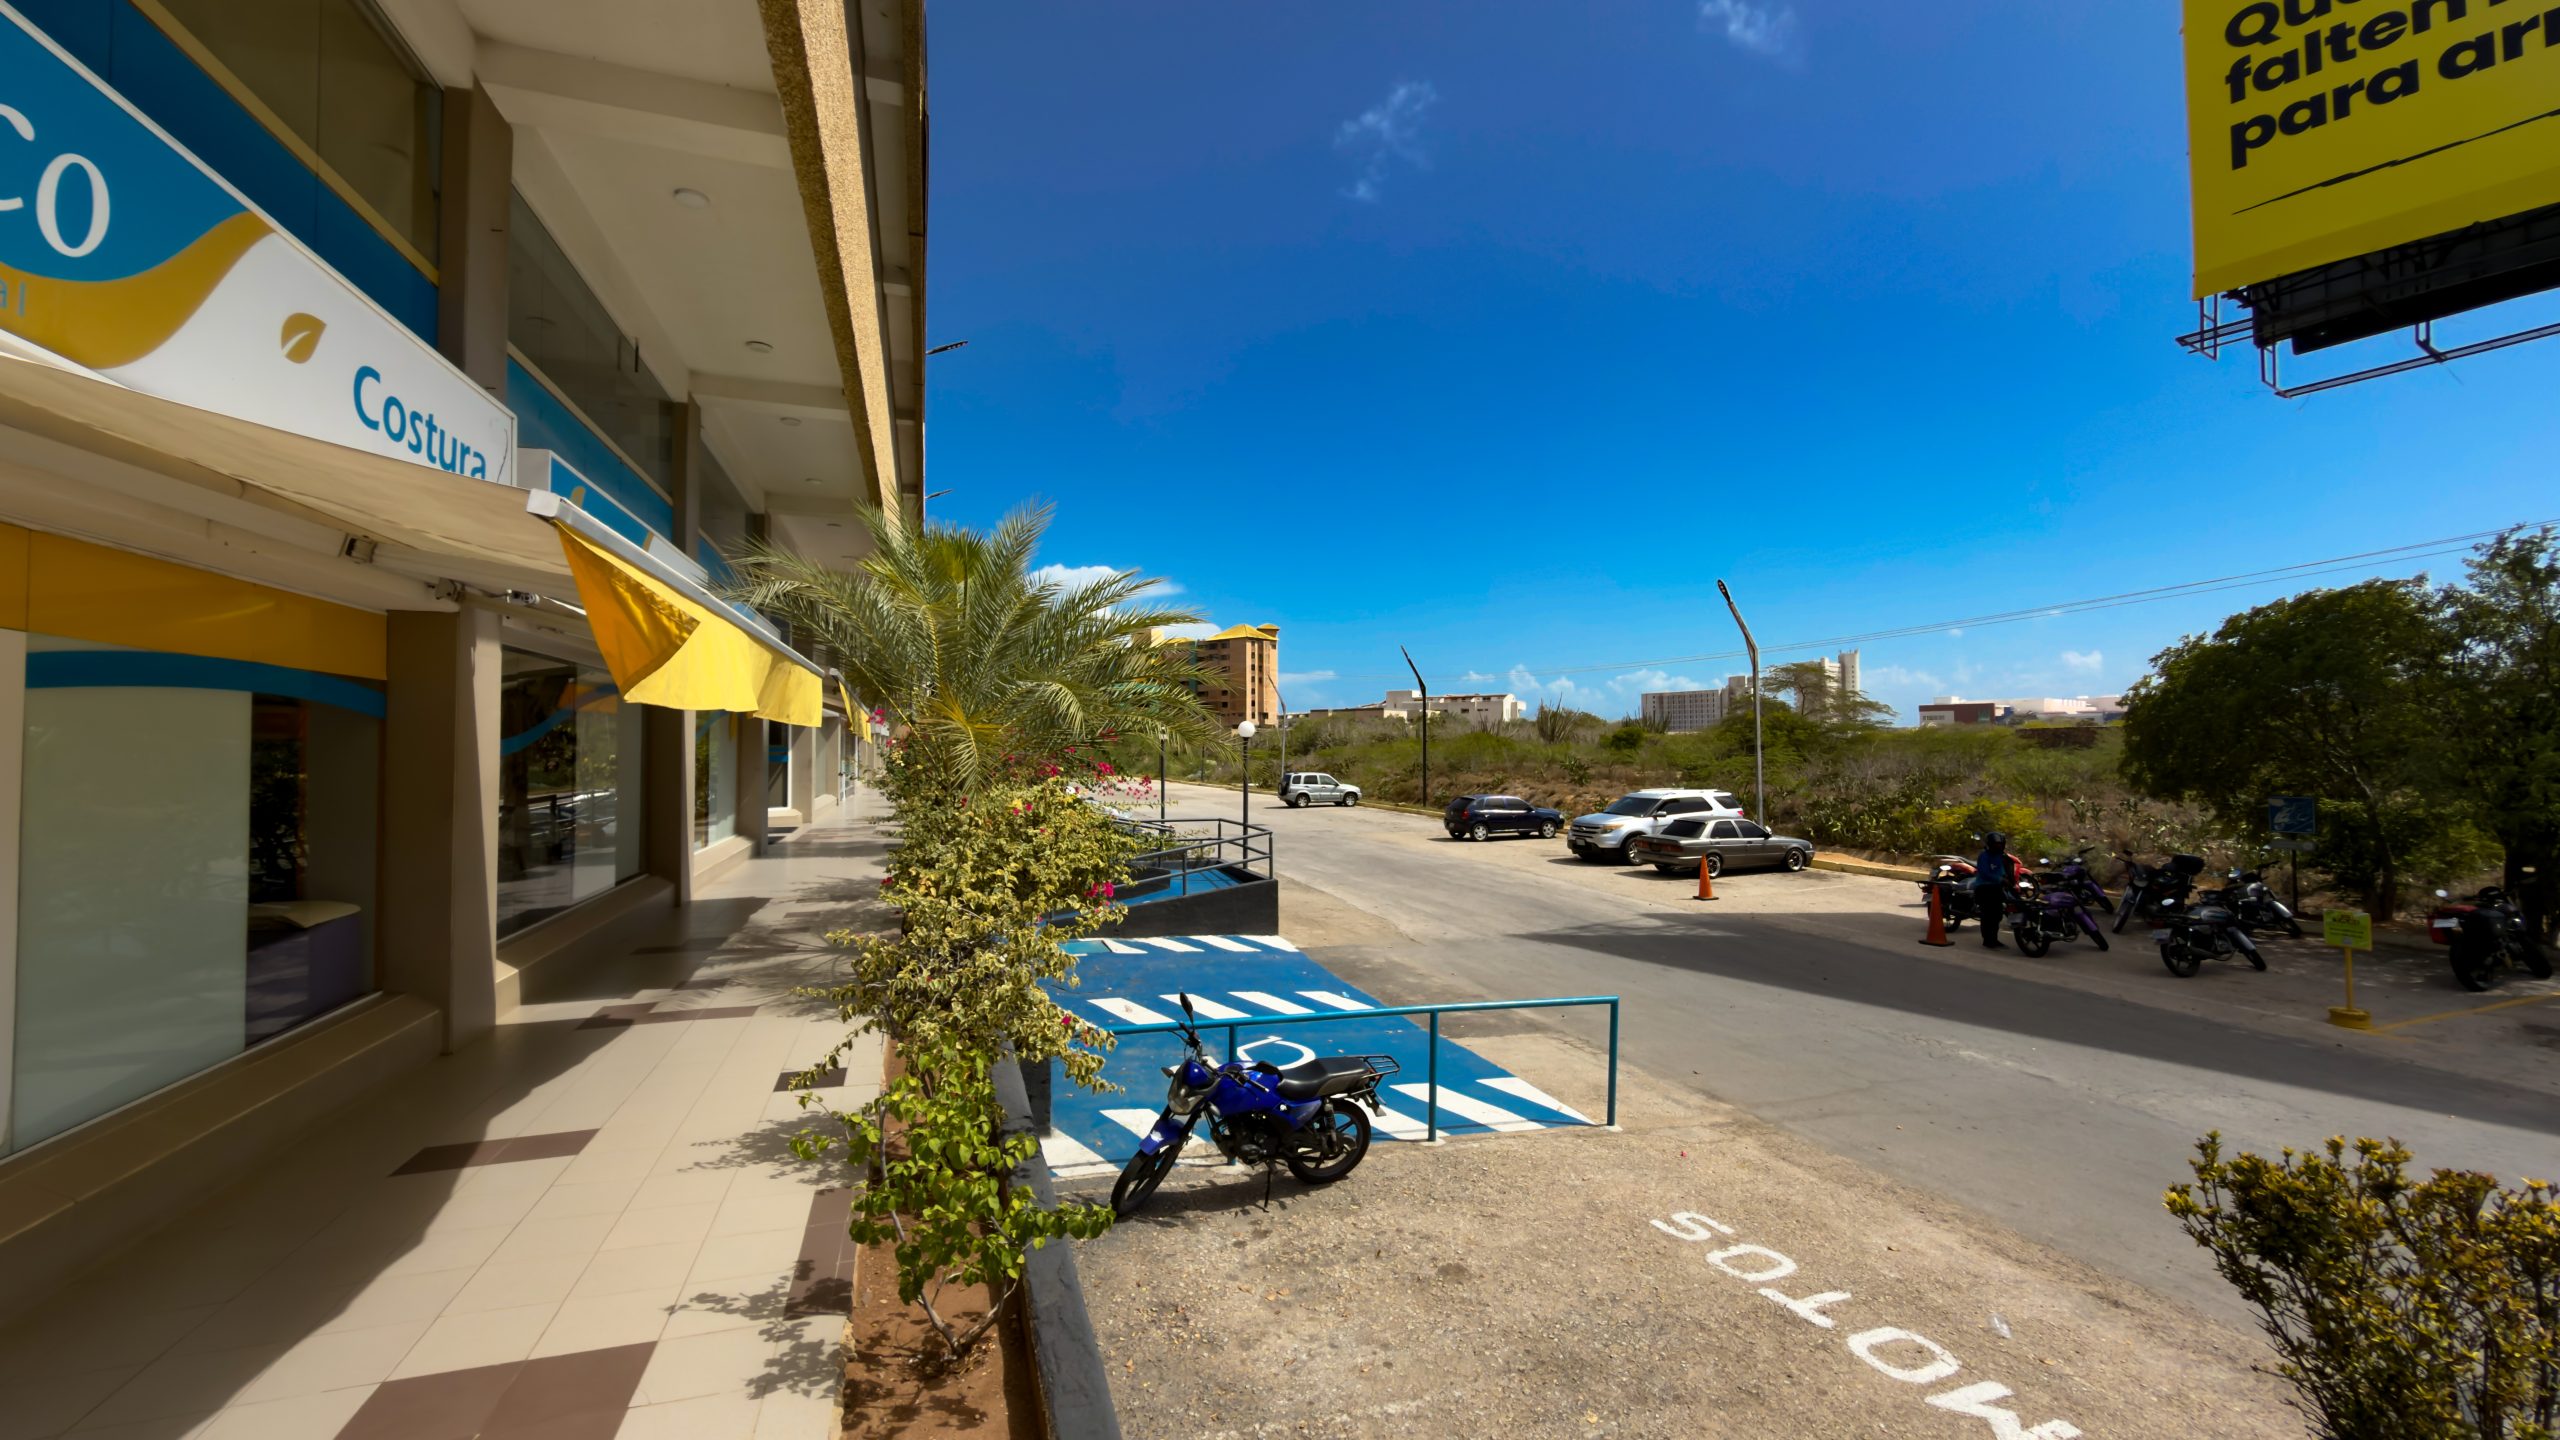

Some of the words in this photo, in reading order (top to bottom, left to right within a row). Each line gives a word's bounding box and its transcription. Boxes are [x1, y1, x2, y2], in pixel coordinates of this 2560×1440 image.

[2225, 0, 2363, 47] Qu
[2225, 0, 2467, 105] falten
[2230, 58, 2420, 171] para
[353, 365, 487, 480] Costura
[1650, 1211, 2083, 1440] MOTOS
